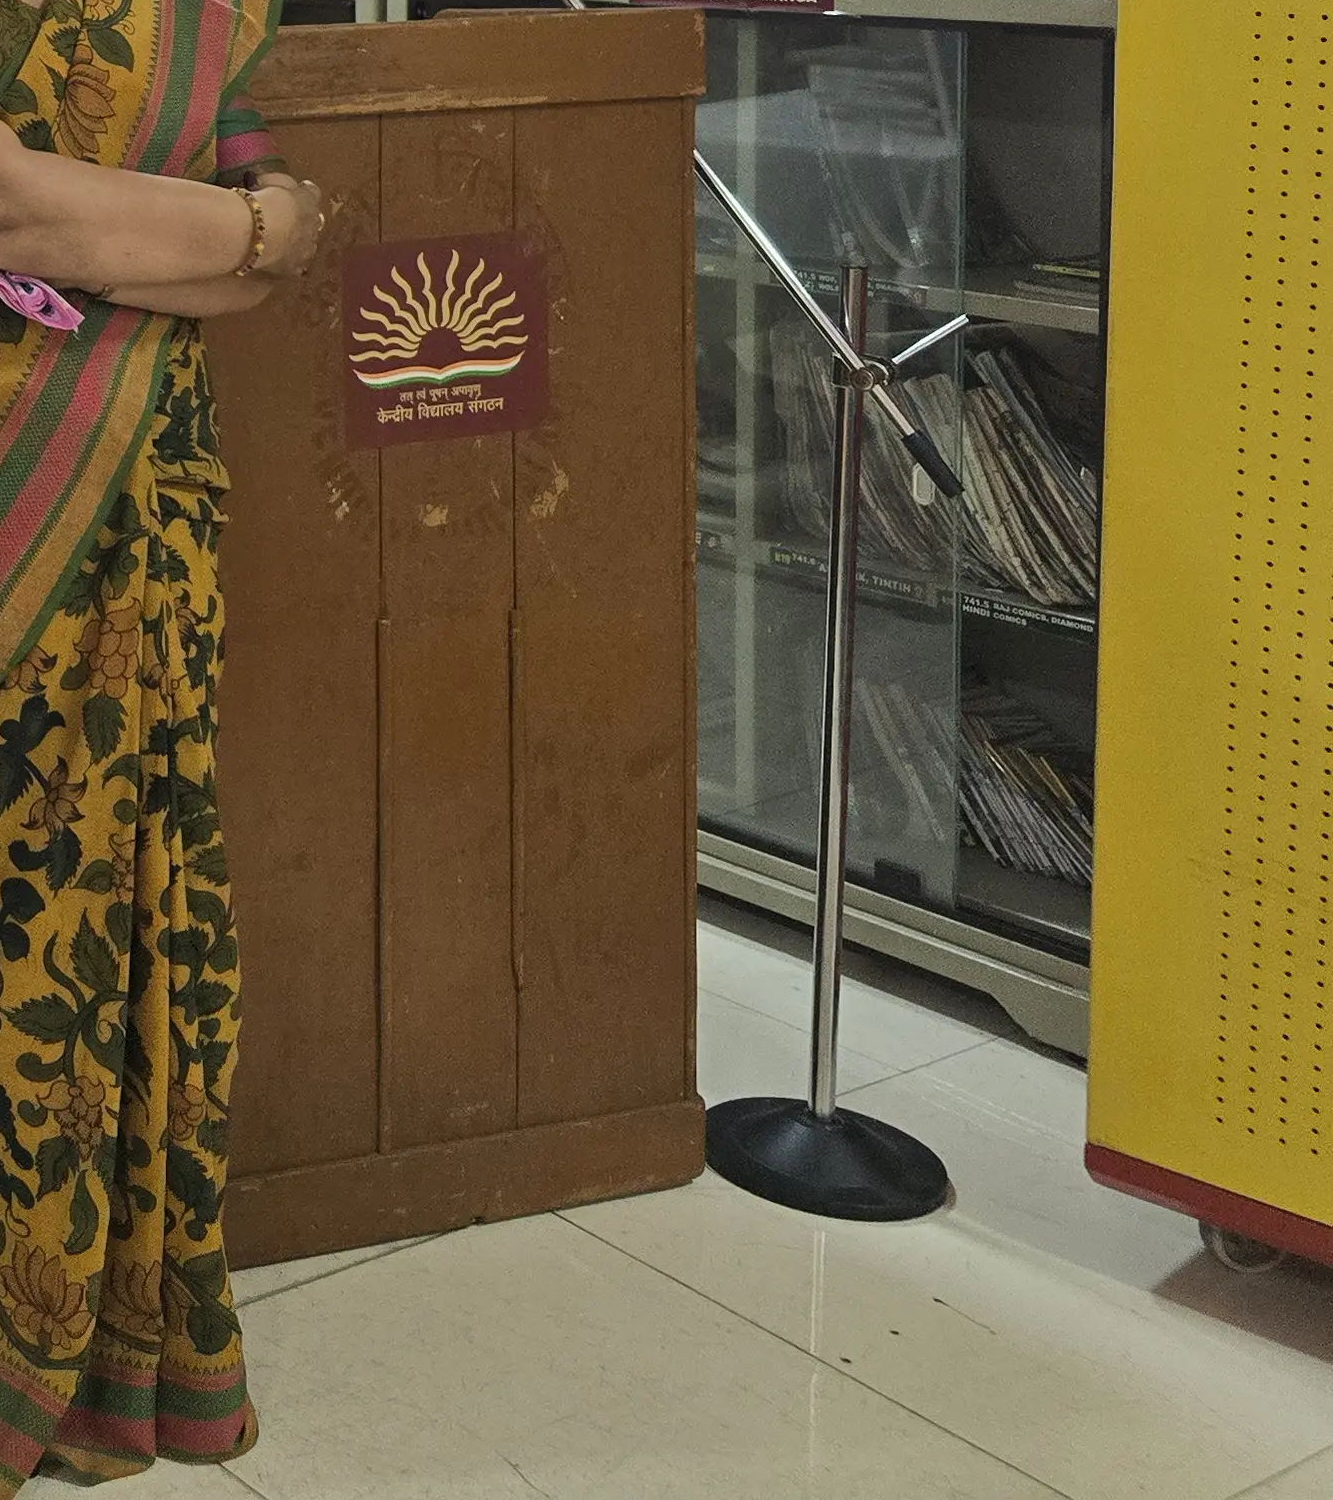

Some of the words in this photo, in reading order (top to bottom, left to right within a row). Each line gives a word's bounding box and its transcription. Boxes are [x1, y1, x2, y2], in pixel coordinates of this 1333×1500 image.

[377, 406, 413, 424] केन्द्रीय
[418, 401, 464, 421] विद्यालय
[468, 396, 504, 413] संगठन
[963, 595, 990, 610] 741.5
[1012, 606, 1050, 623] COMICS,
[1051, 616, 1094, 633] DIAMOND
[963, 605, 991, 618] HINDI
[993, 612, 1027, 627] COMICS
